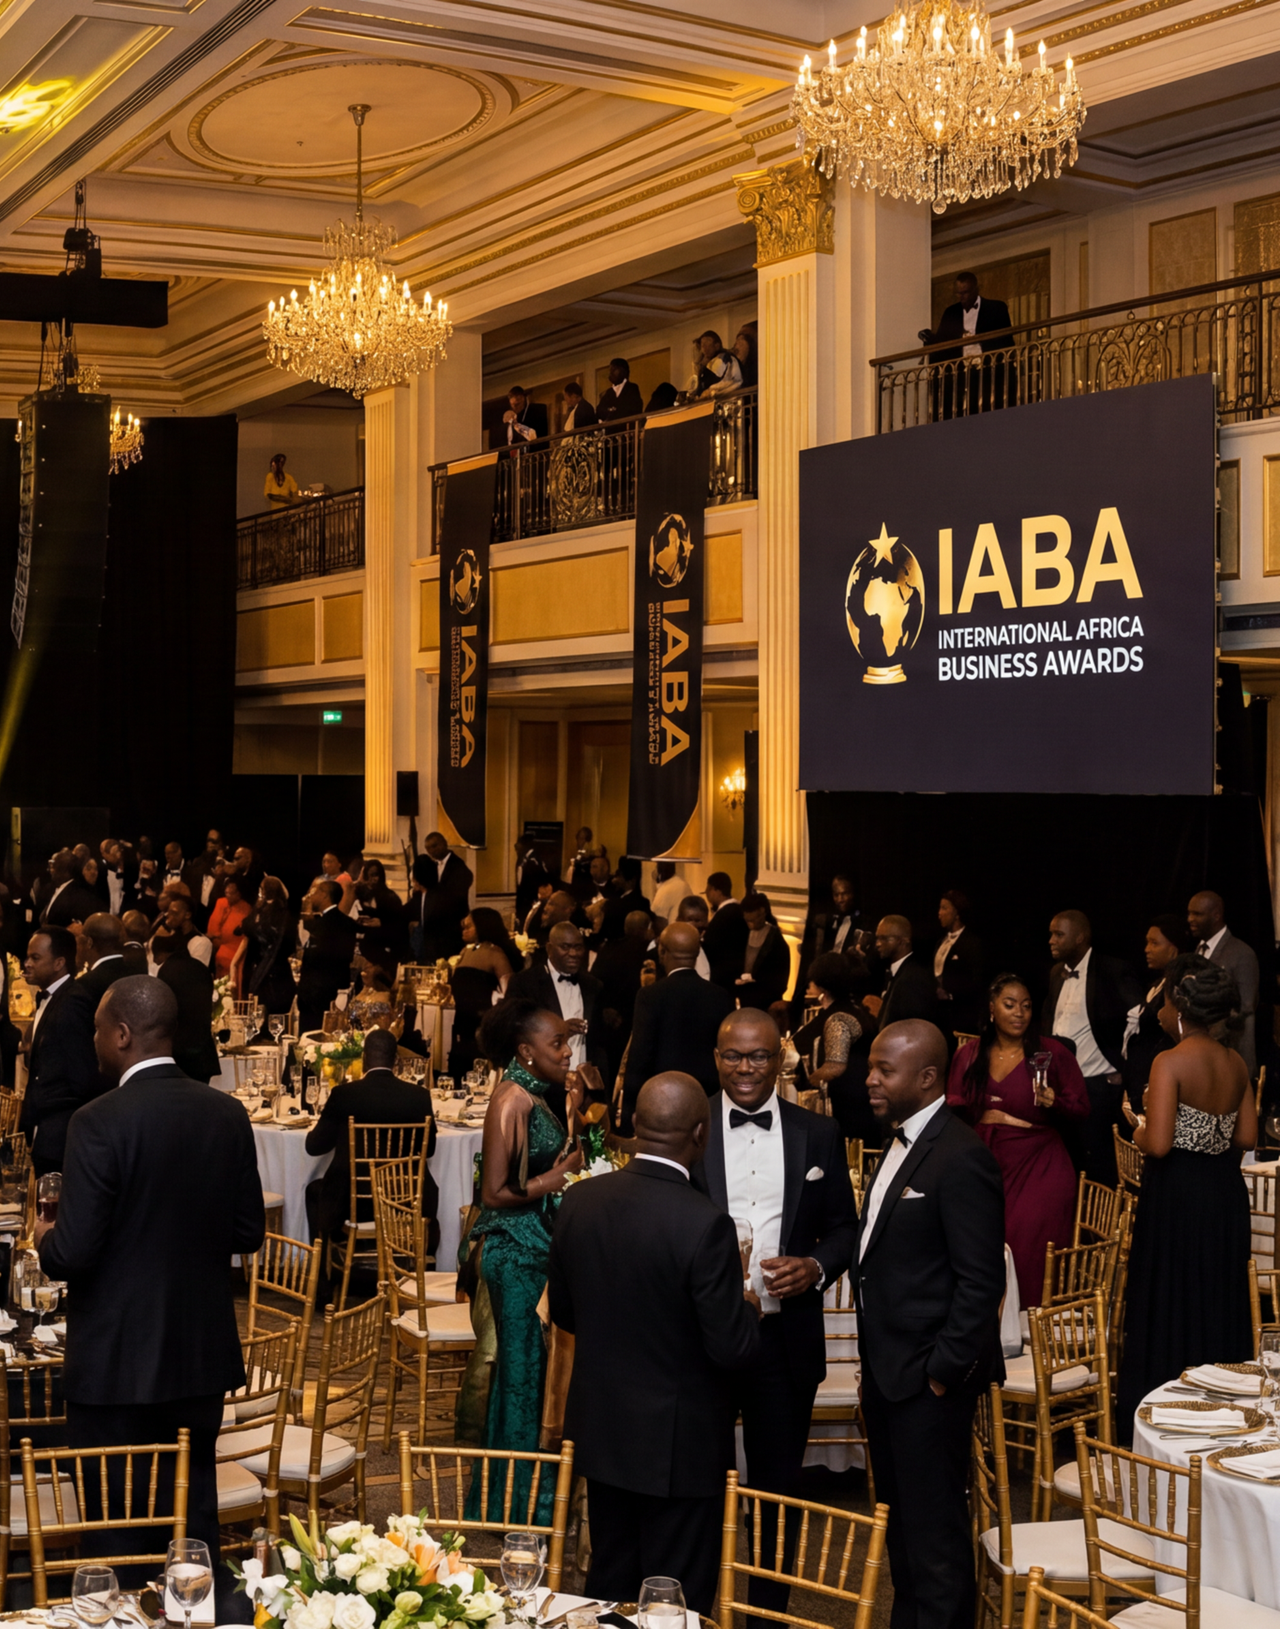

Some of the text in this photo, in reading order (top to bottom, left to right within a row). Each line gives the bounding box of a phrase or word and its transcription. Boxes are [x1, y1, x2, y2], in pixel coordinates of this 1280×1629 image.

[938, 506, 1144, 615] IABA
[660, 598, 690, 767] IABA
[938, 615, 1144, 650] INTERNATIONAL AFRICA
[938, 645, 1144, 681] BUSINESS AWARDS
[460, 625, 477, 768] IABA
